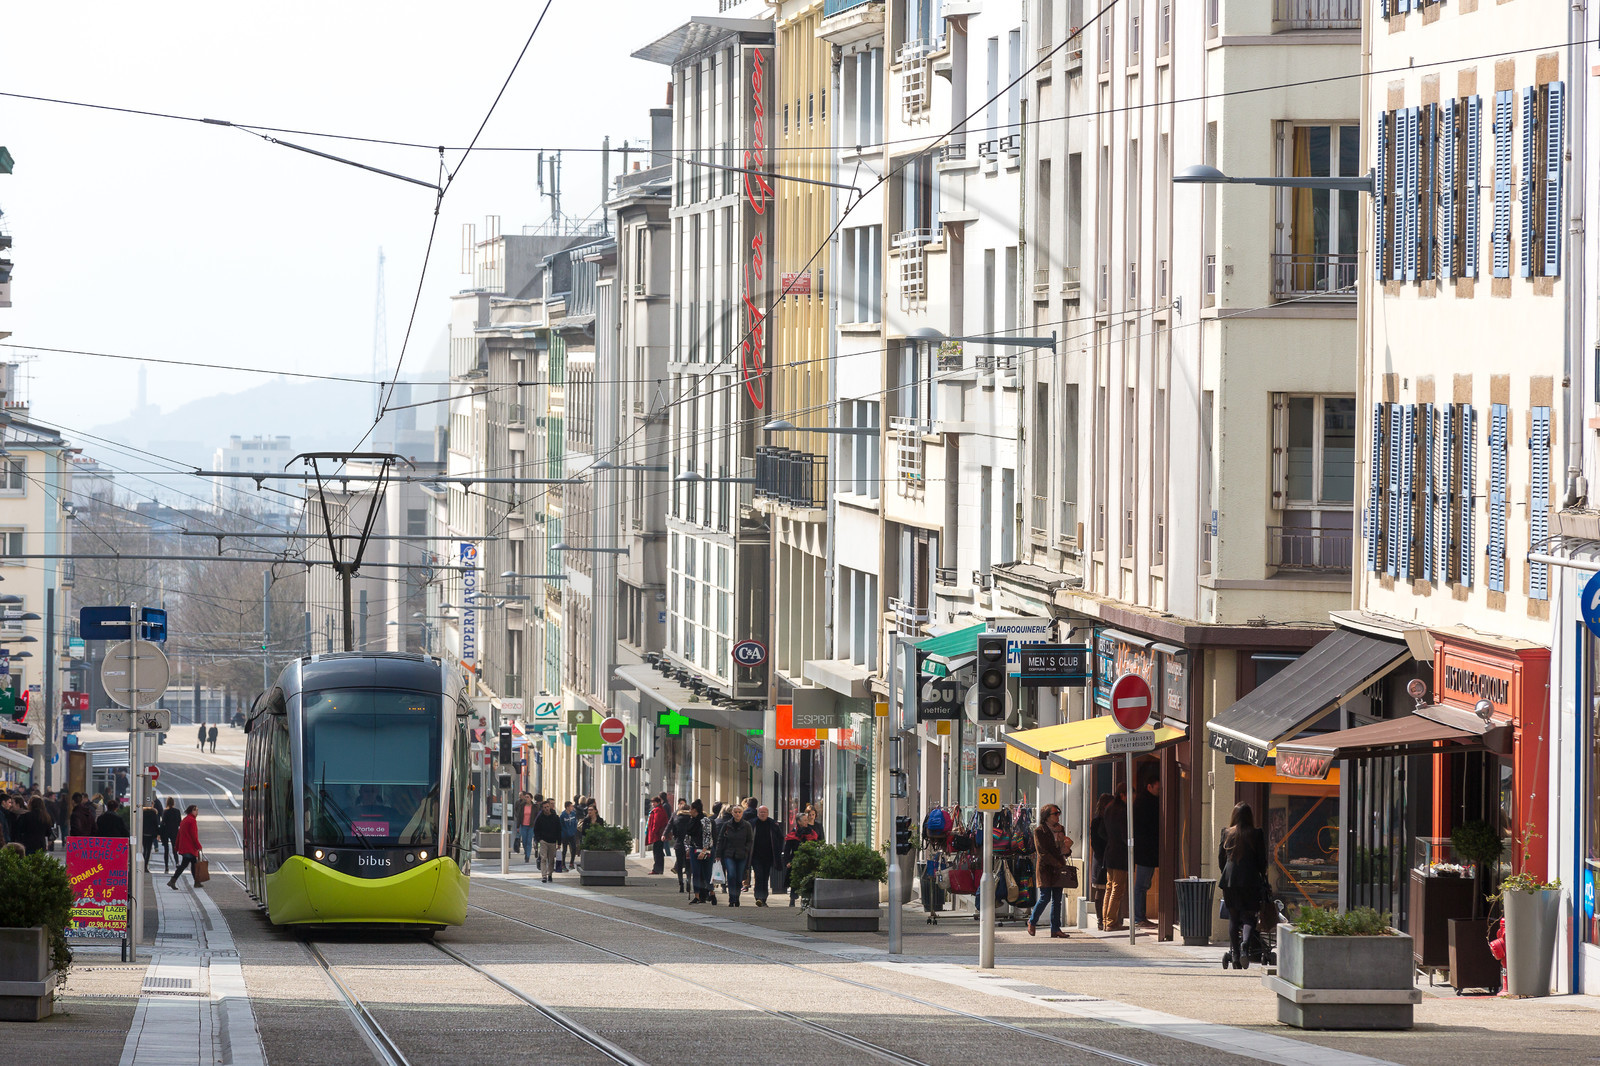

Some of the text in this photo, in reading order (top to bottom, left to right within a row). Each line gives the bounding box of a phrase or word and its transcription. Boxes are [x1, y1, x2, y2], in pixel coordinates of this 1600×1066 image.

[752, 231, 762, 280] ar
[996, 625, 1047, 634] MAROQUINERIE
[738, 647, 762, 659] C&A
[1058, 656, 1079, 667] CLUB
[1478, 674, 1509, 704] CHOCOLAT
[924, 706, 951, 714] nettier
[796, 714, 835, 725] ESPRIT
[778, 736, 816, 748] orange
[981, 793, 998, 805] 30
[80, 849, 114, 860] MICHEL
[358, 855, 391, 866] bibus
[106, 878, 127, 886] SOIR
